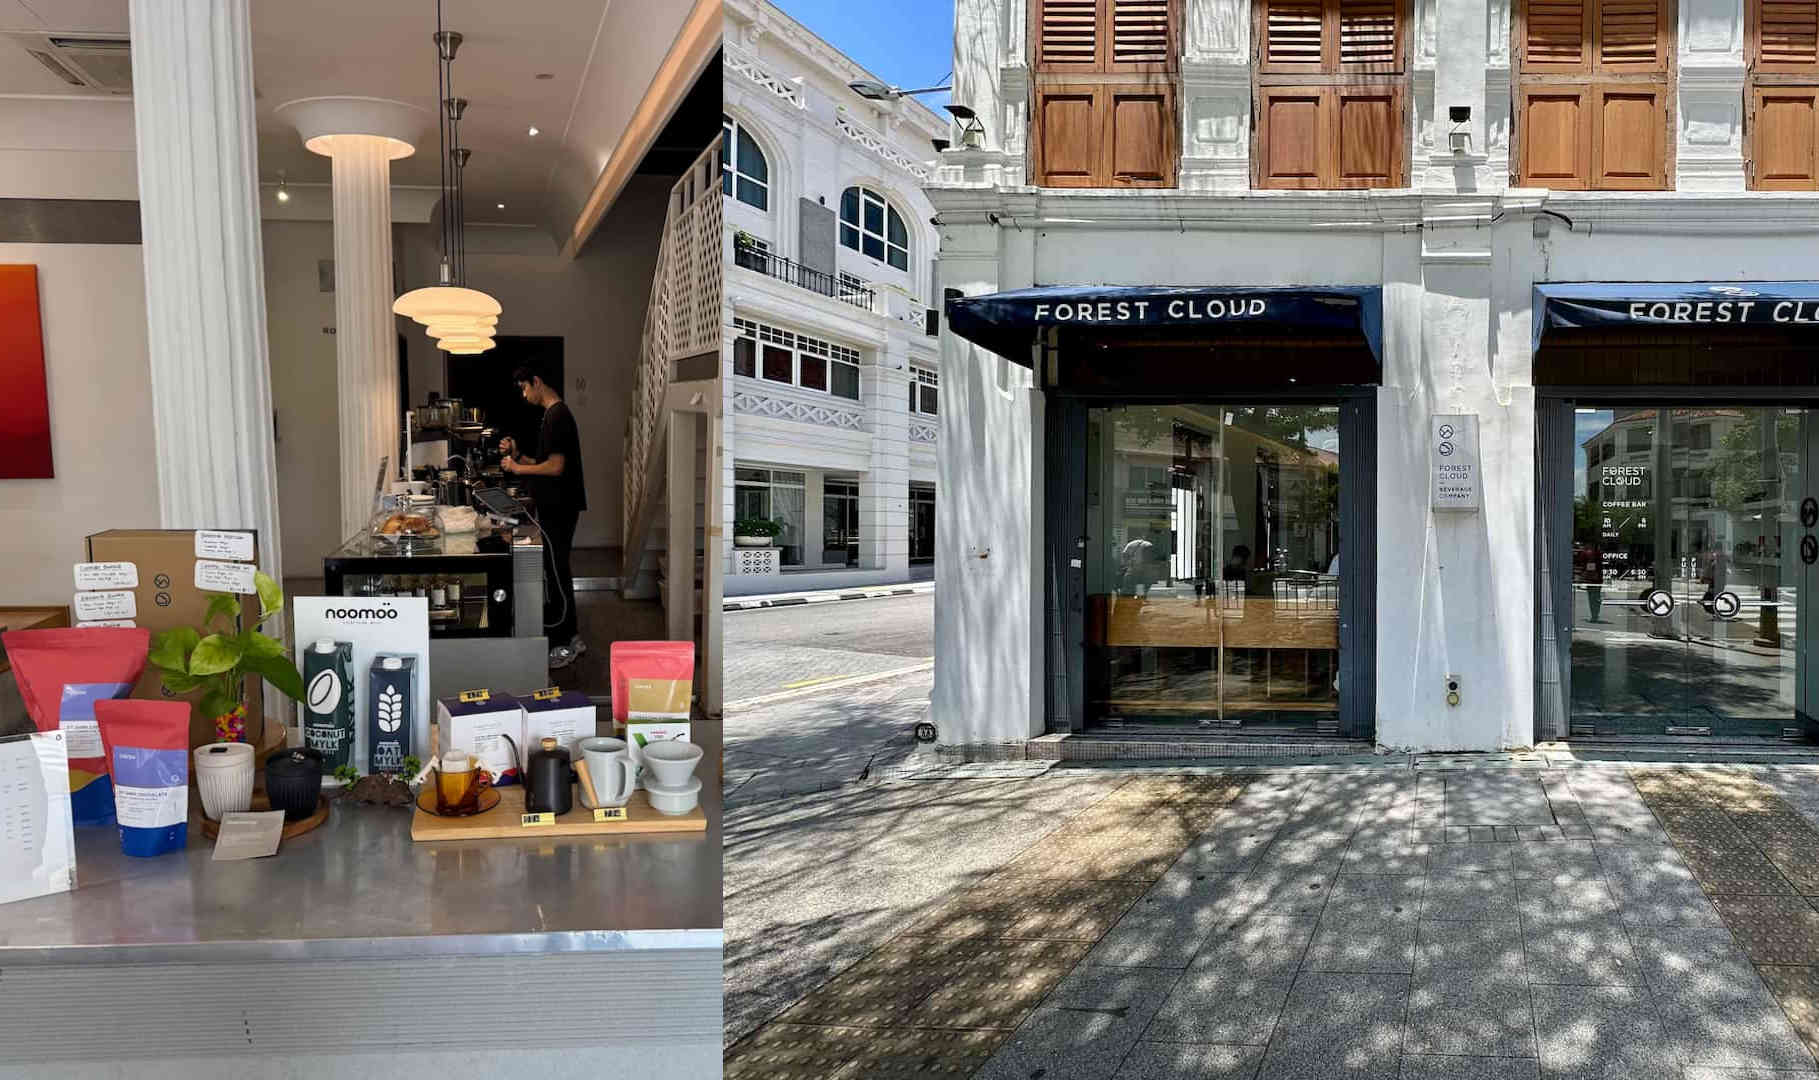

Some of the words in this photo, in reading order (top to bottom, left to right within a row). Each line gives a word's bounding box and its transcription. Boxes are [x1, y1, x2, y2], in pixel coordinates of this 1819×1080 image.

[1034, 301, 1149, 321] FOREST
[1167, 299, 1266, 319] CLOUD
[1629, 301, 1755, 323] FOREST
[1772, 301, 1819, 323] CL
[1439, 464, 1472, 472] FOREST
[1602, 466, 1646, 476] FOREST
[1439, 472, 1468, 480] CLOUD
[1602, 476, 1641, 486] CLOUD
[305, 728, 345, 738] COCONUT
[311, 739, 339, 749] MYLK
[377, 746, 400, 756] OAT
